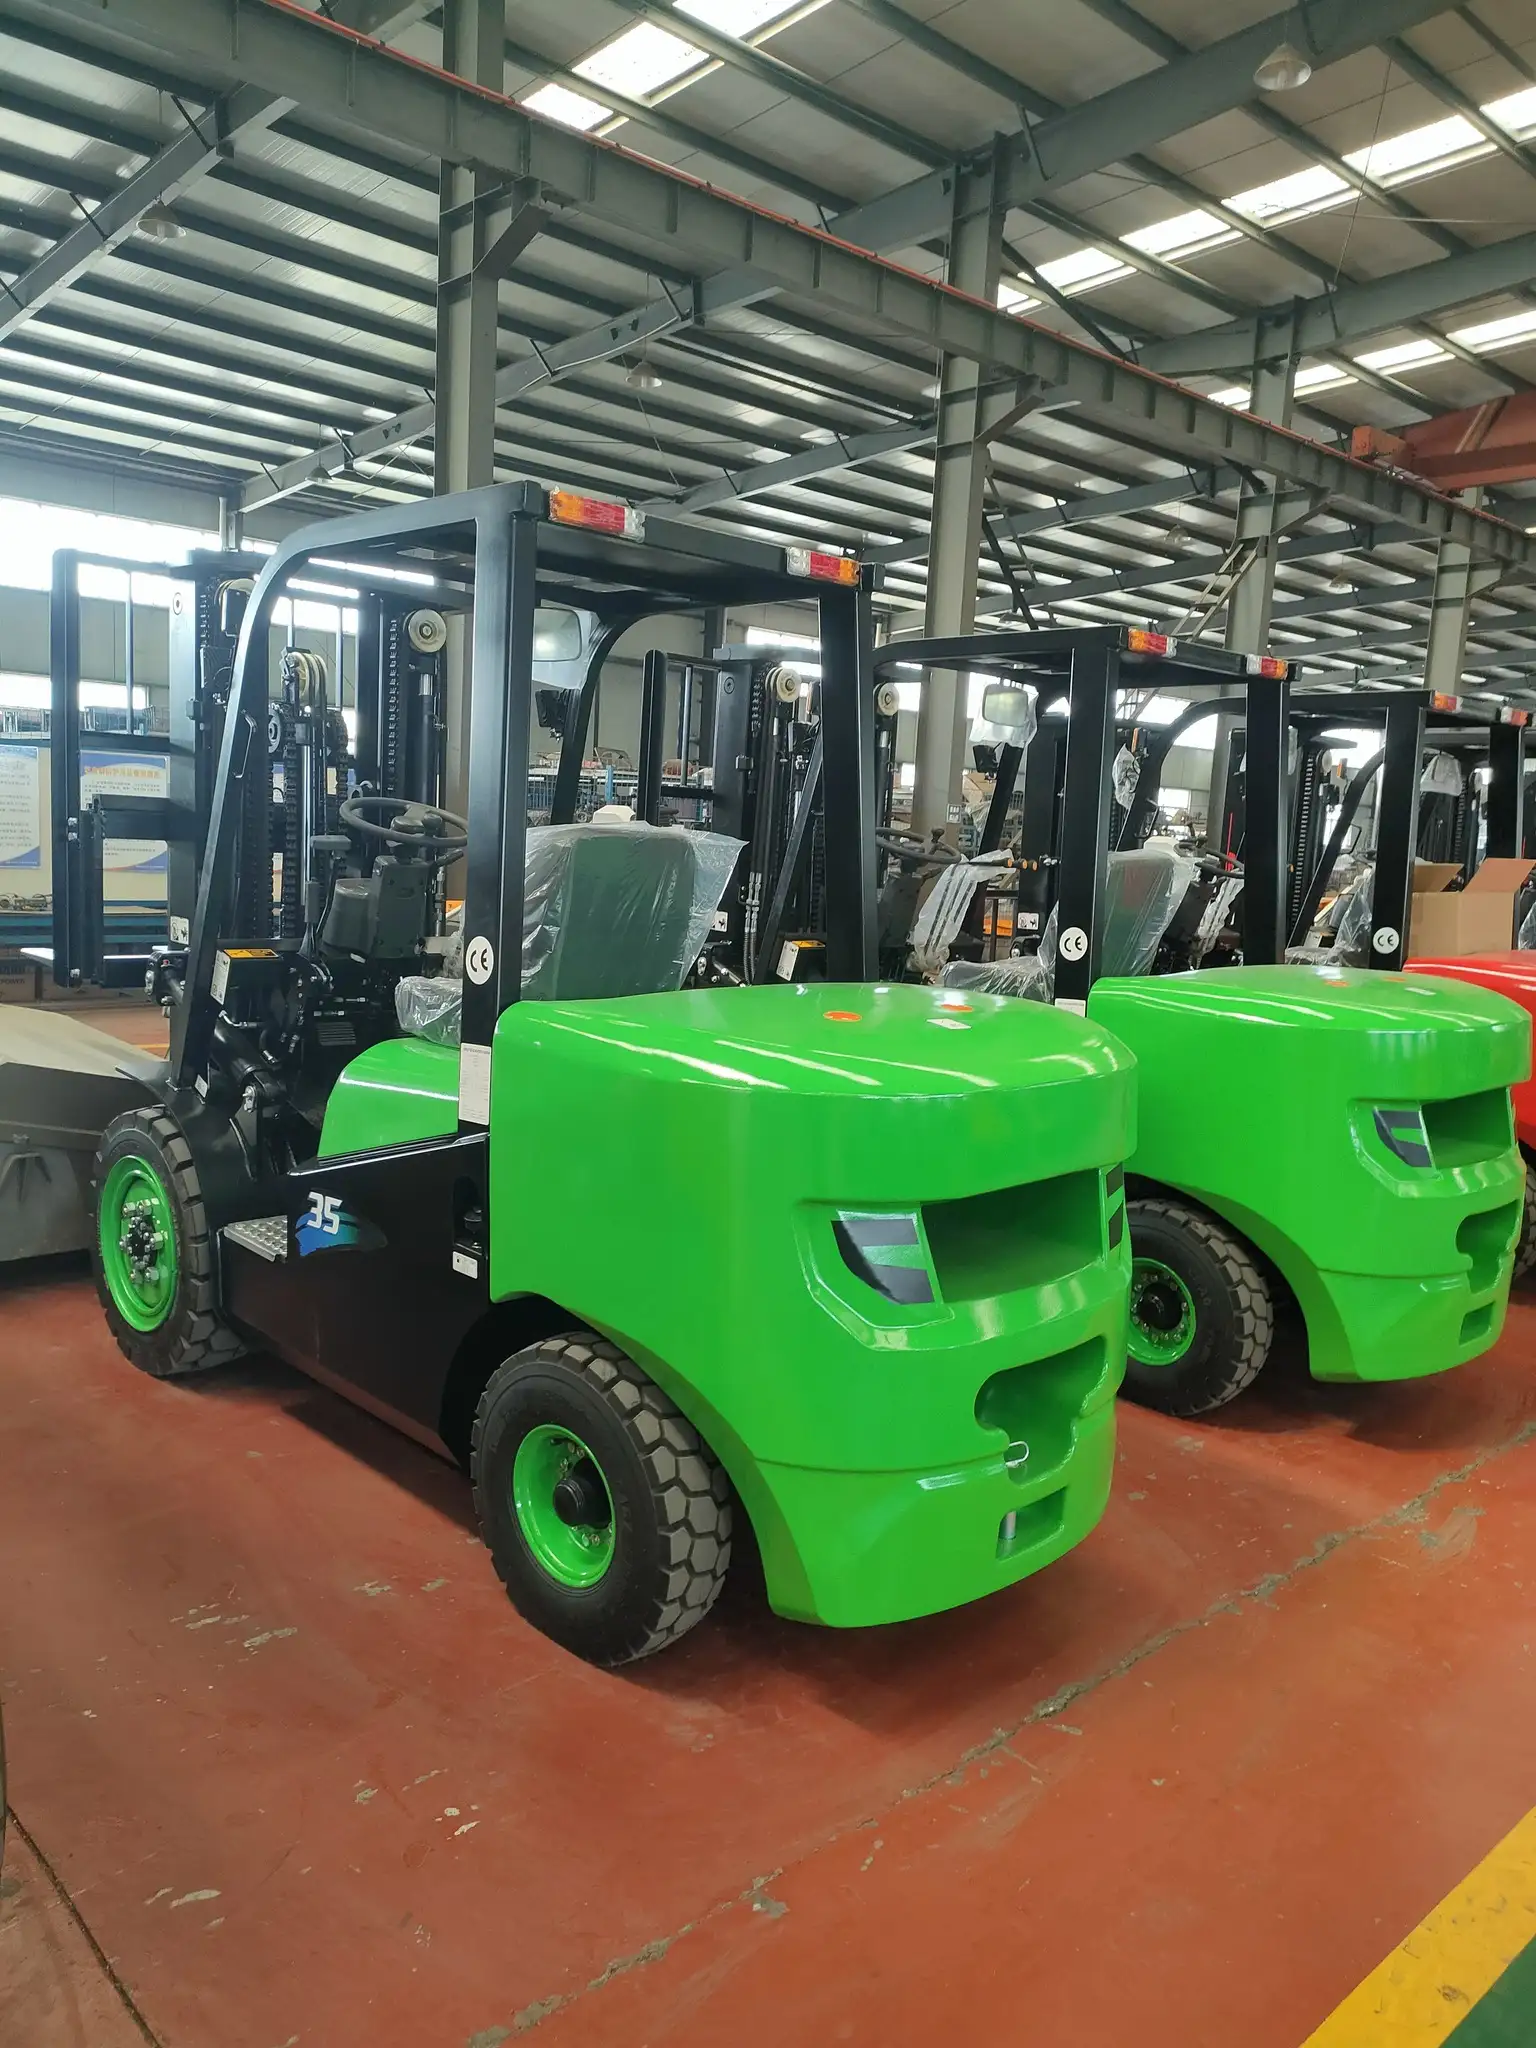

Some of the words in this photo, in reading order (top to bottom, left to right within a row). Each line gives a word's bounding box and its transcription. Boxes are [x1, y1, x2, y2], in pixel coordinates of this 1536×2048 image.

[1064, 936, 1082, 952] CE
[1377, 934, 1394, 947] CE
[470, 948, 488, 973] CE
[307, 1191, 343, 1235] 35
